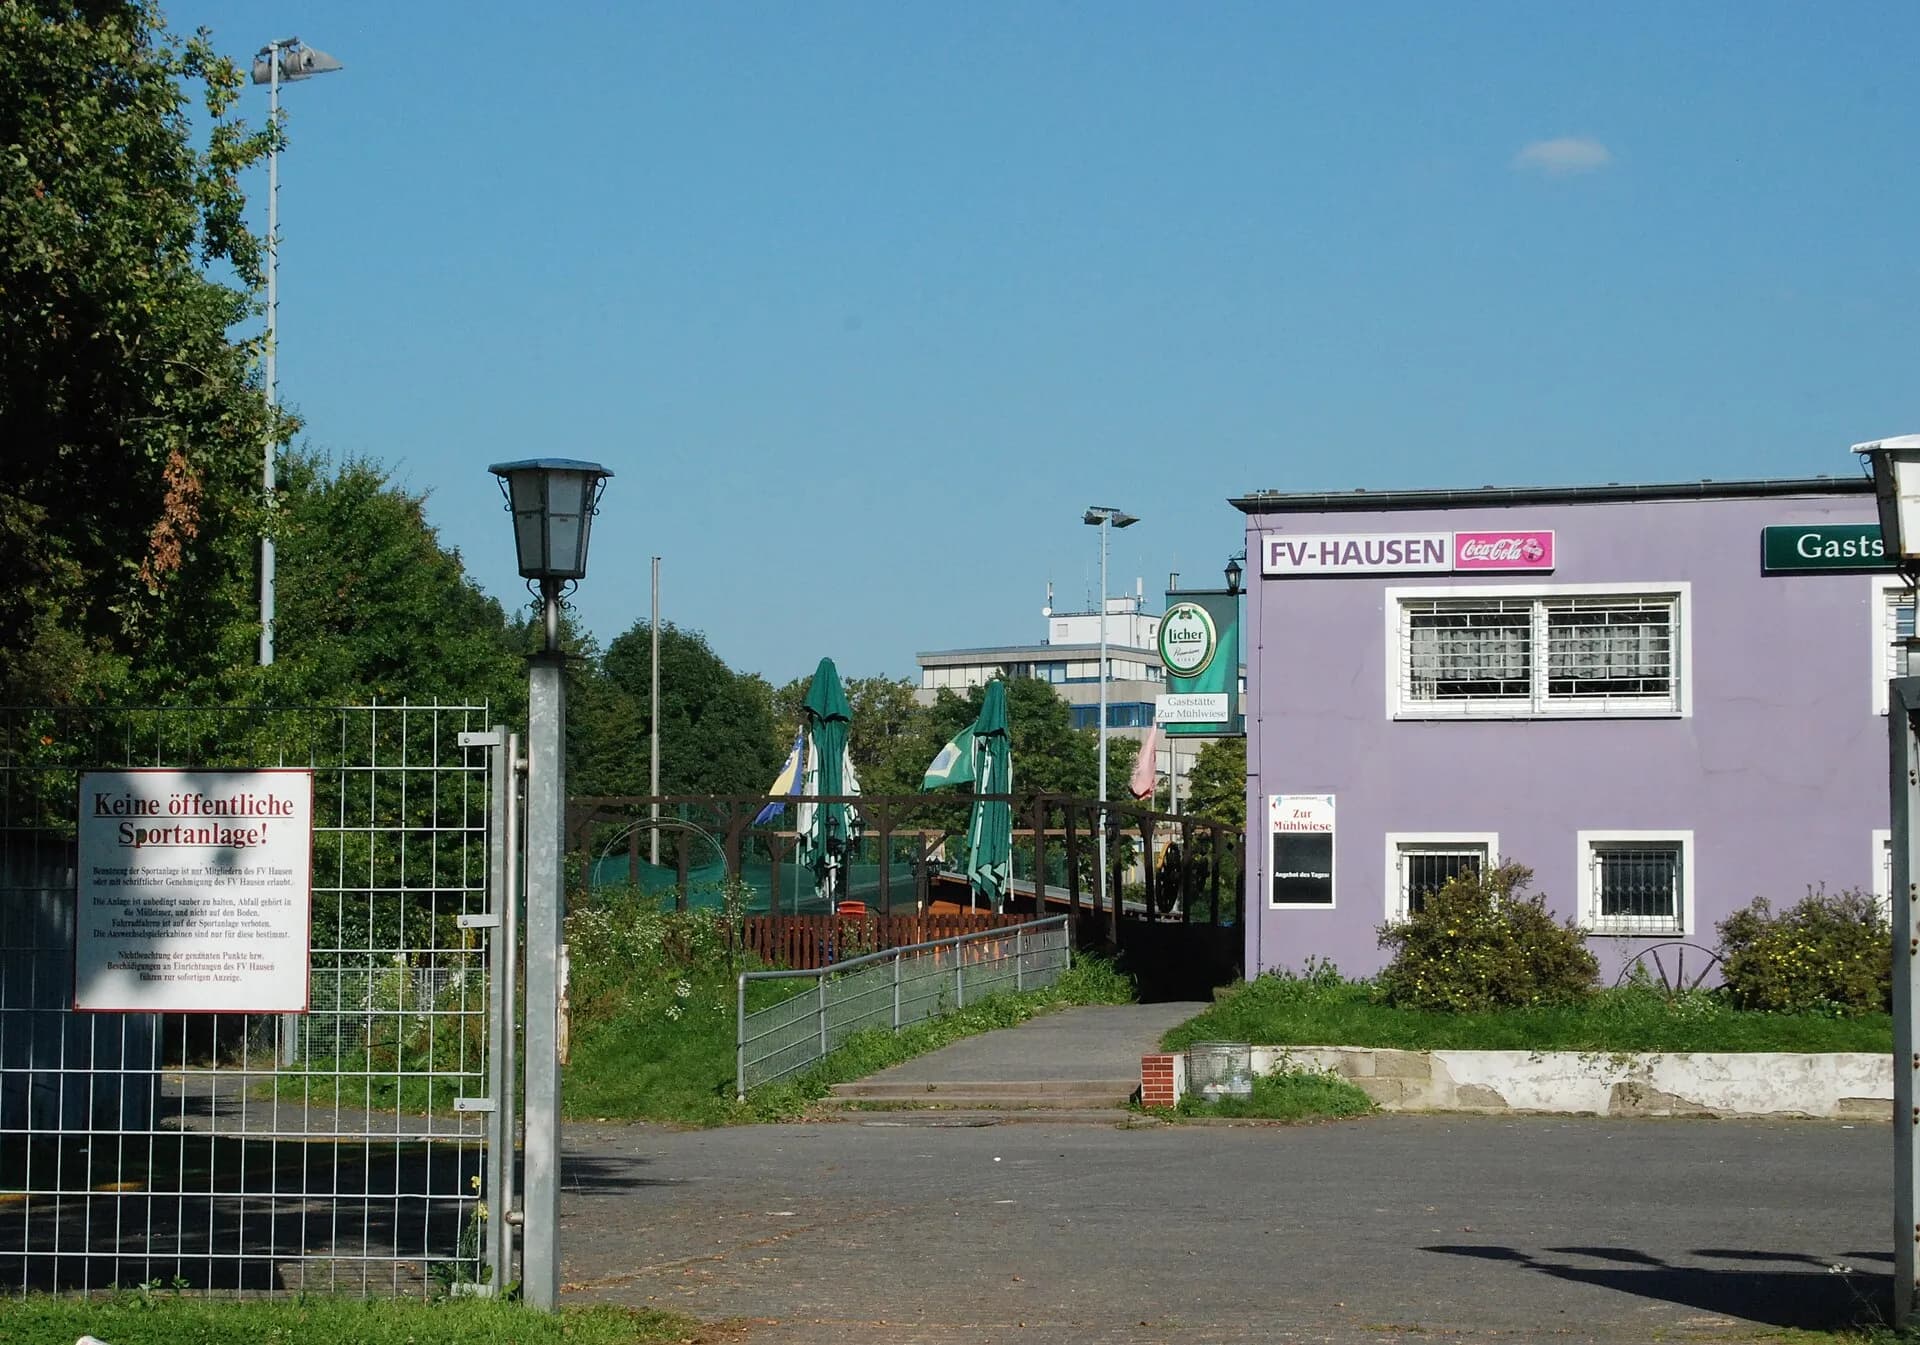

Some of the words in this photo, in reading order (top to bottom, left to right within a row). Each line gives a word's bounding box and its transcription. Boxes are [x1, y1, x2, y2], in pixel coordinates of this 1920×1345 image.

[1270, 539, 1445, 566] FV-HAUSEN
[1460, 537, 1523, 561] Coca-Cola
[1169, 628, 1204, 644] Licher
[1167, 697, 1216, 706] Gaststätte
[1158, 710, 1175, 718] Zur
[1177, 709, 1226, 718] Mühlwiese
[94, 793, 160, 815] Keine
[168, 793, 294, 815] öffentliche
[1293, 809, 1312, 818] Zur
[1273, 820, 1332, 831] Mühlwiese
[118, 822, 267, 848] Sportanlage!
[141, 866, 179, 876] Sportanlage
[181, 866, 189, 875] ist
[256, 866, 265, 875] FV
[165, 878, 213, 887] Genehmigung
[143, 897, 177, 907] unbedingt
[178, 897, 200, 905] sauber
[190, 908, 207, 916] nicht
[199, 919, 239, 928] Sportanlage
